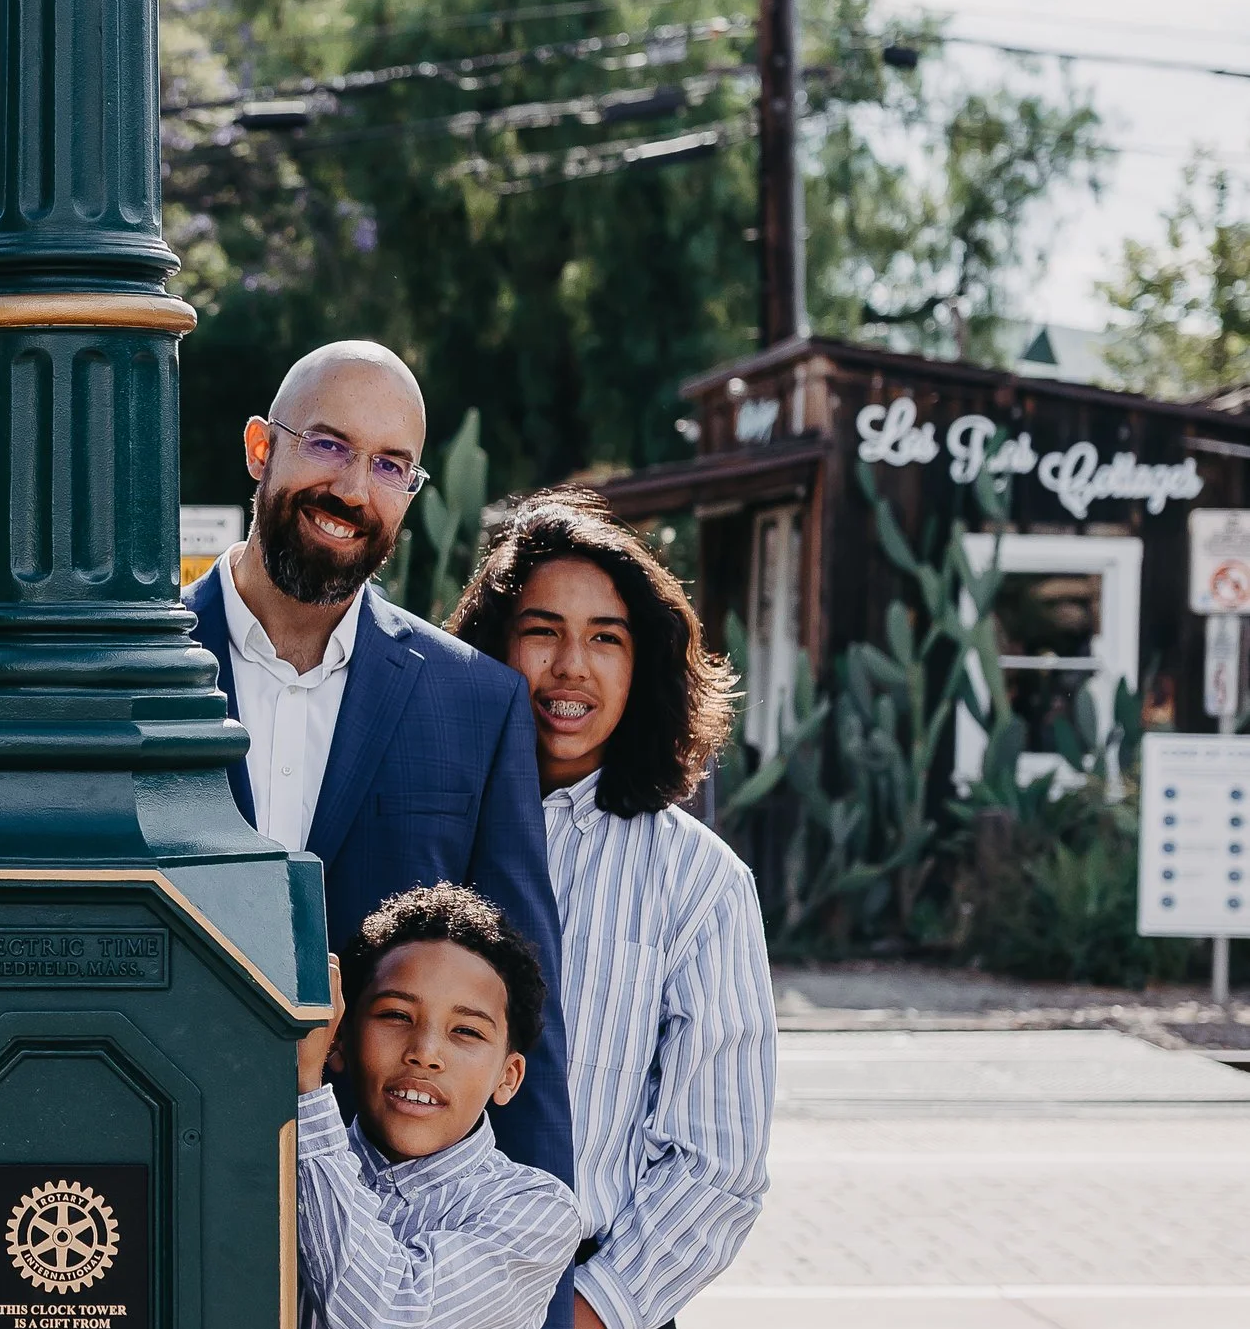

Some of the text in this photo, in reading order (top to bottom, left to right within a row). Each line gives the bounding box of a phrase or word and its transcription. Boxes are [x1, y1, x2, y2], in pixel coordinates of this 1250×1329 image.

[98, 938, 160, 958] TIME
[86, 960, 146, 977] MASS.
[40, 1193, 85, 1206] ROTARY
[24, 1253, 101, 1281] INTERNATIONAL
[31, 1305, 76, 1315] CLOCK
[78, 1305, 127, 1315] TOWER
[15, 1318, 110, 1329] IS A GIFT FROM
